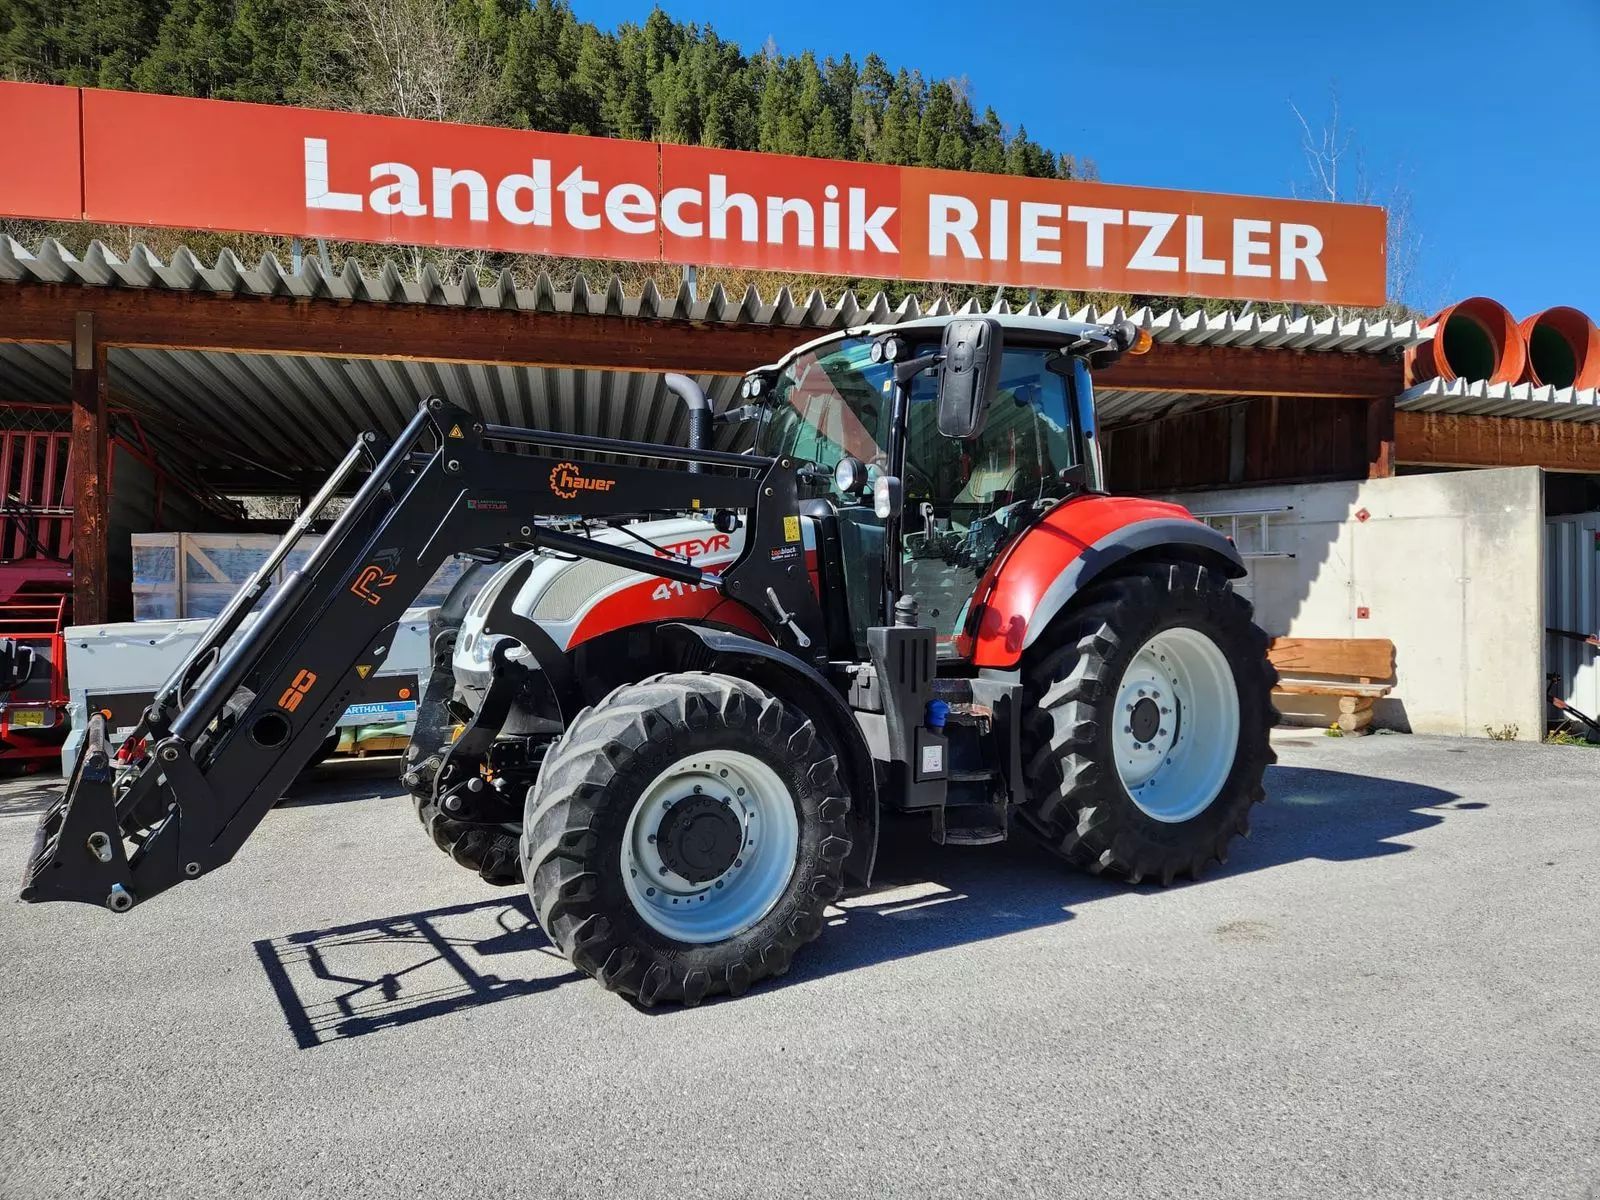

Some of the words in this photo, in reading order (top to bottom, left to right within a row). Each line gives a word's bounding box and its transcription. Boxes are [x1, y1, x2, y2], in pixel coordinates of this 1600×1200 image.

[303, 137, 900, 254] Landtechnik
[928, 193, 1328, 282] RIETZLER
[560, 470, 616, 491] hauer
